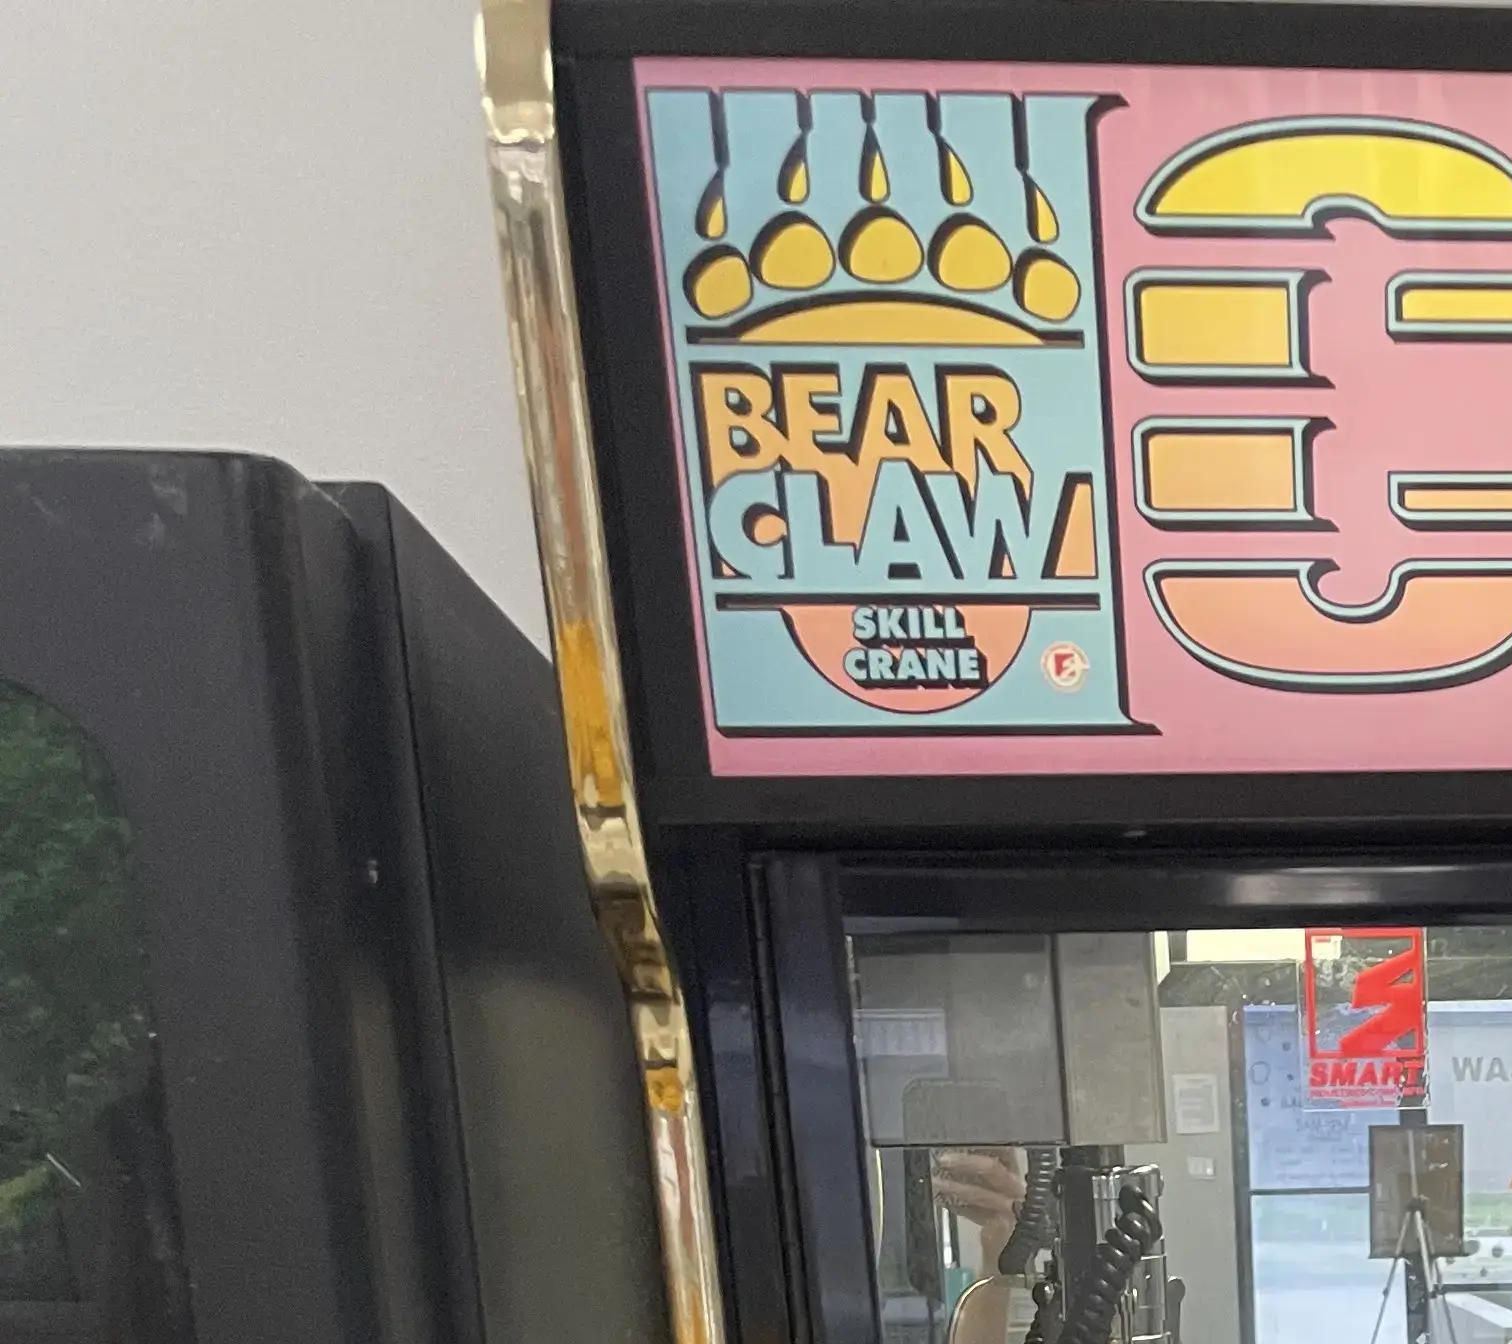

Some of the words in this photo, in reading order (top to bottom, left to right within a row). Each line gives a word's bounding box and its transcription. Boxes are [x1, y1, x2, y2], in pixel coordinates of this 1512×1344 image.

[690, 362, 1034, 482] BEAR
[706, 458, 1080, 579] CLAW
[852, 606, 972, 644] SKILL
[842, 647, 985, 685] CRANE
[1309, 1061, 1424, 1087] SMART
